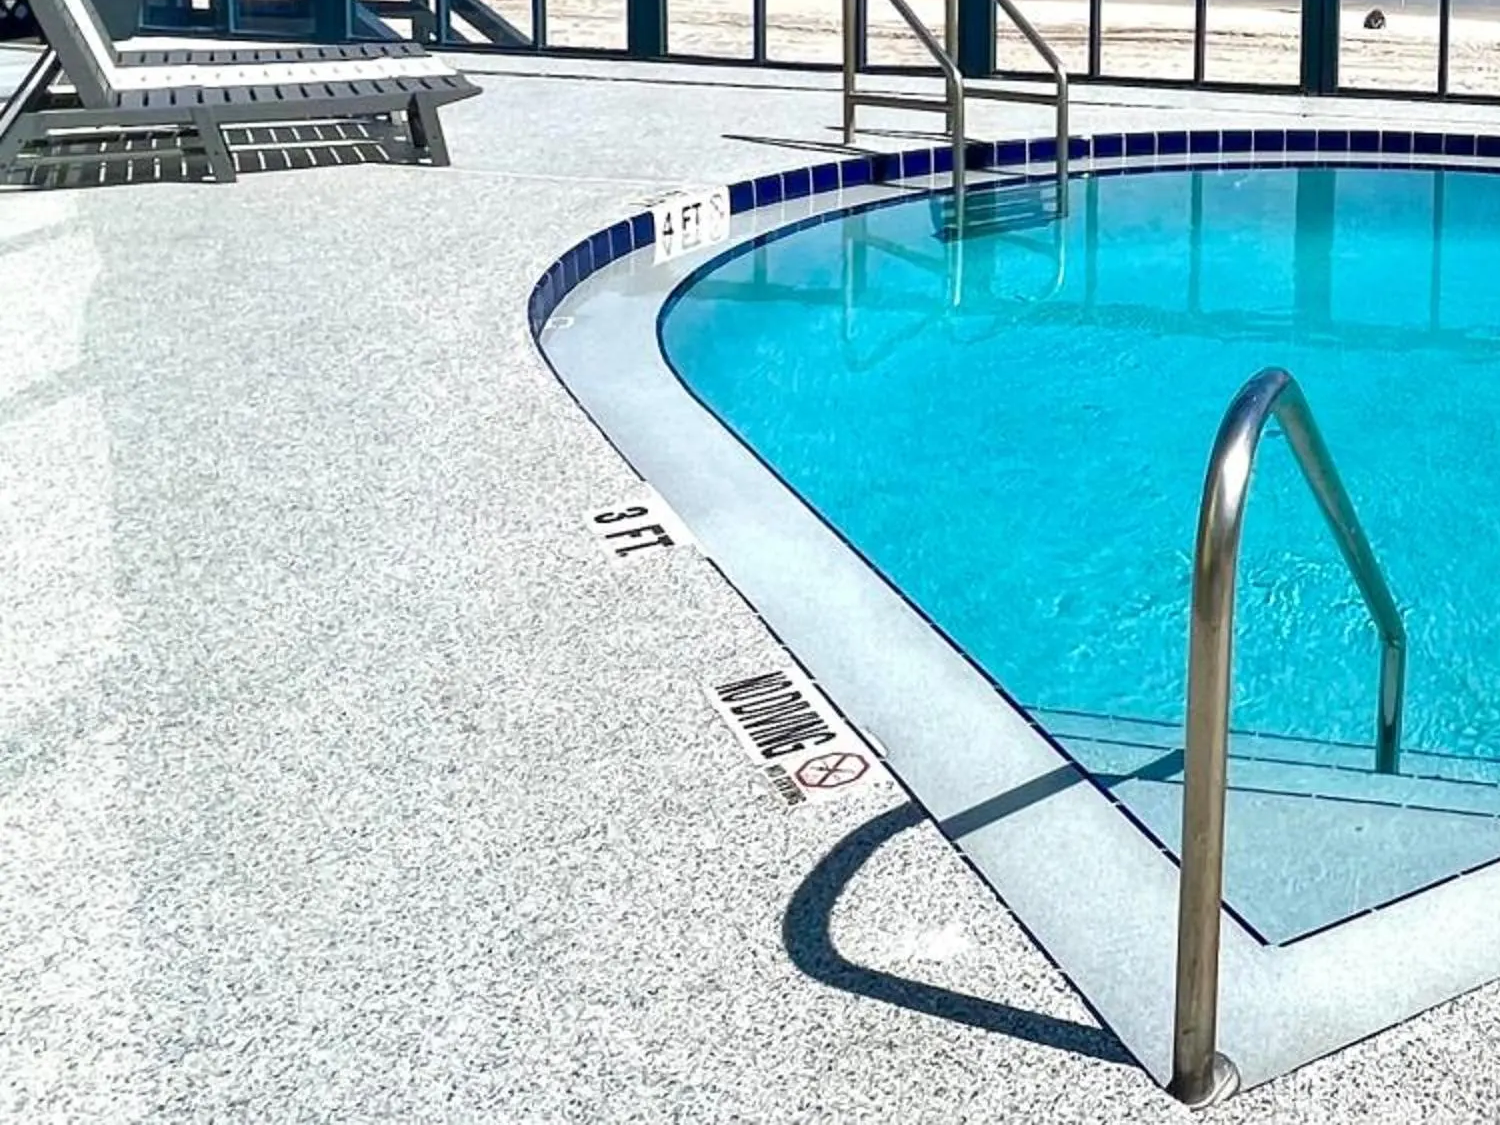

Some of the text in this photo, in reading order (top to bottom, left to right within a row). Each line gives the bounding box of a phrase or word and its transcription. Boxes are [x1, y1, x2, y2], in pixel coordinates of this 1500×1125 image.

[662, 202, 702, 236] 4 FT
[594, 506, 674, 554] 3 FT
[714, 670, 837, 760] NO DIVING
